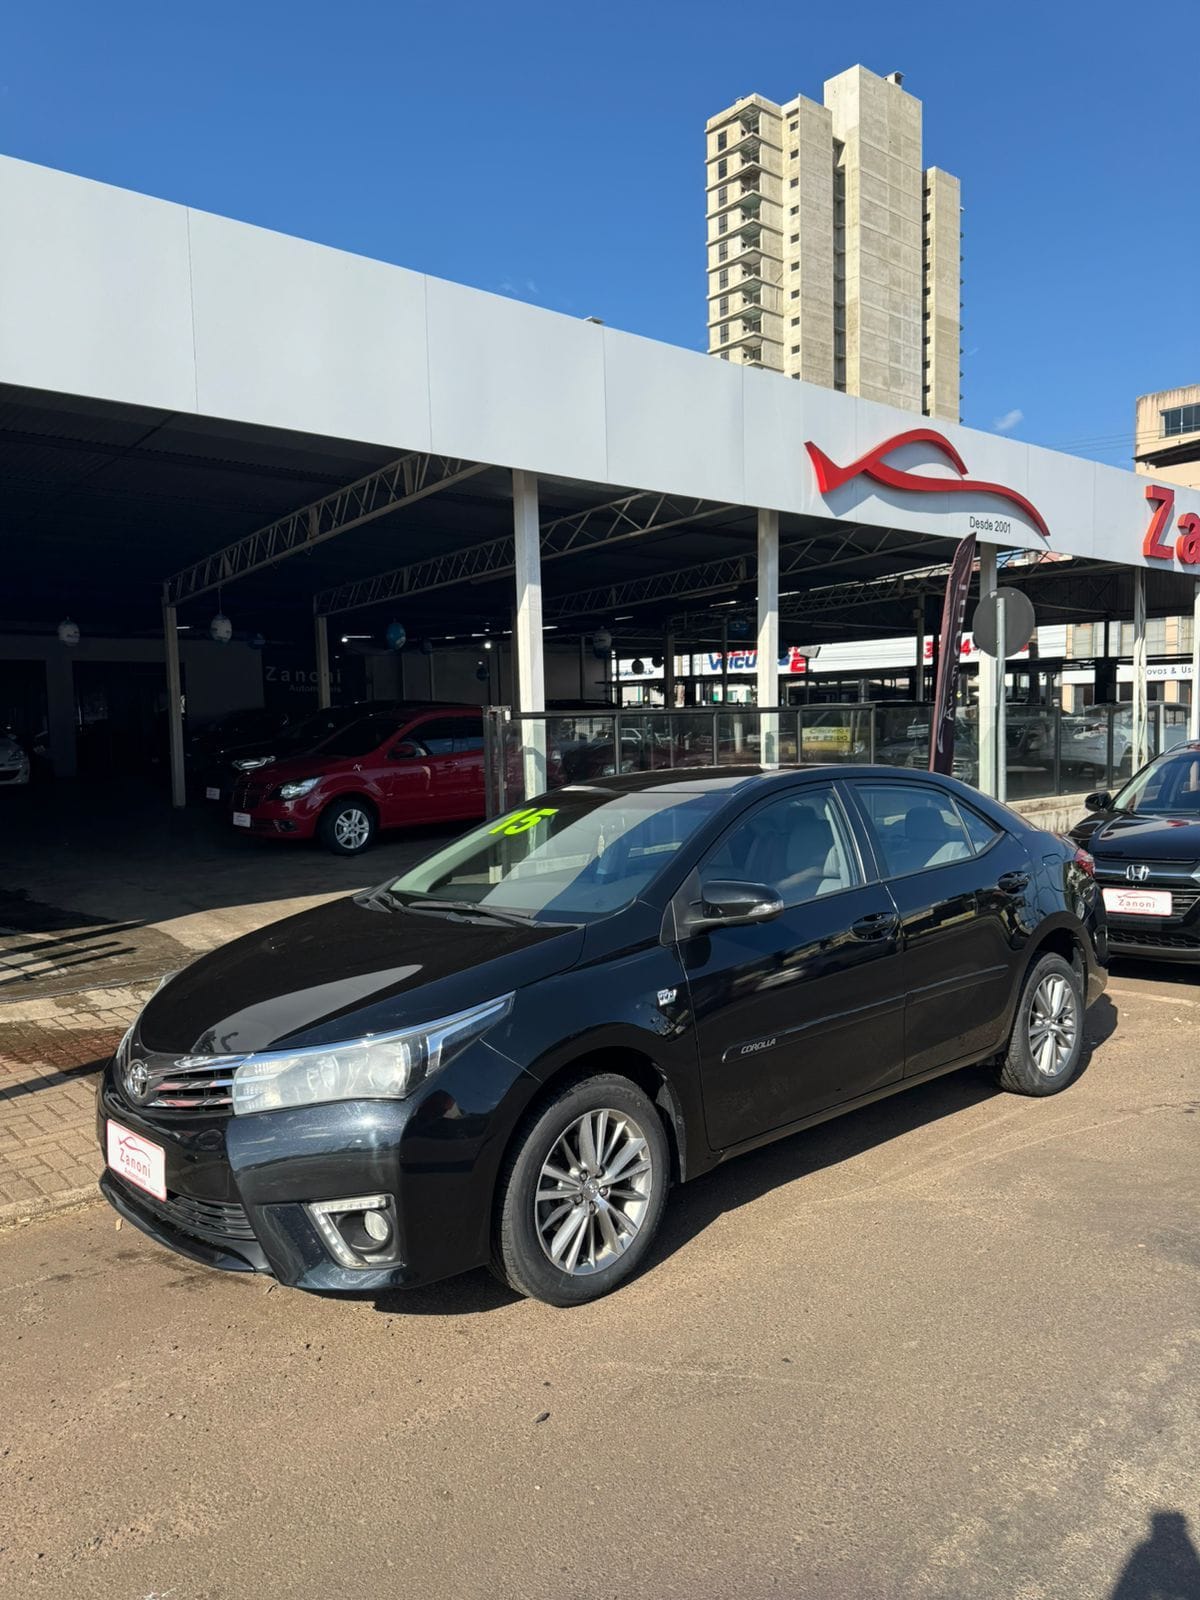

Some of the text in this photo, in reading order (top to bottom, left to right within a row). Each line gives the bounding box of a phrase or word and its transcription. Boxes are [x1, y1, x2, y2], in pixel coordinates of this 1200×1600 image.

[969, 515, 1011, 533] Desde 2001
[488, 807, 559, 835] 15
[1118, 898, 1155, 908] Zanoni
[740, 1038, 776, 1054] COROLLA
[119, 1147, 151, 1179] Zanoni
